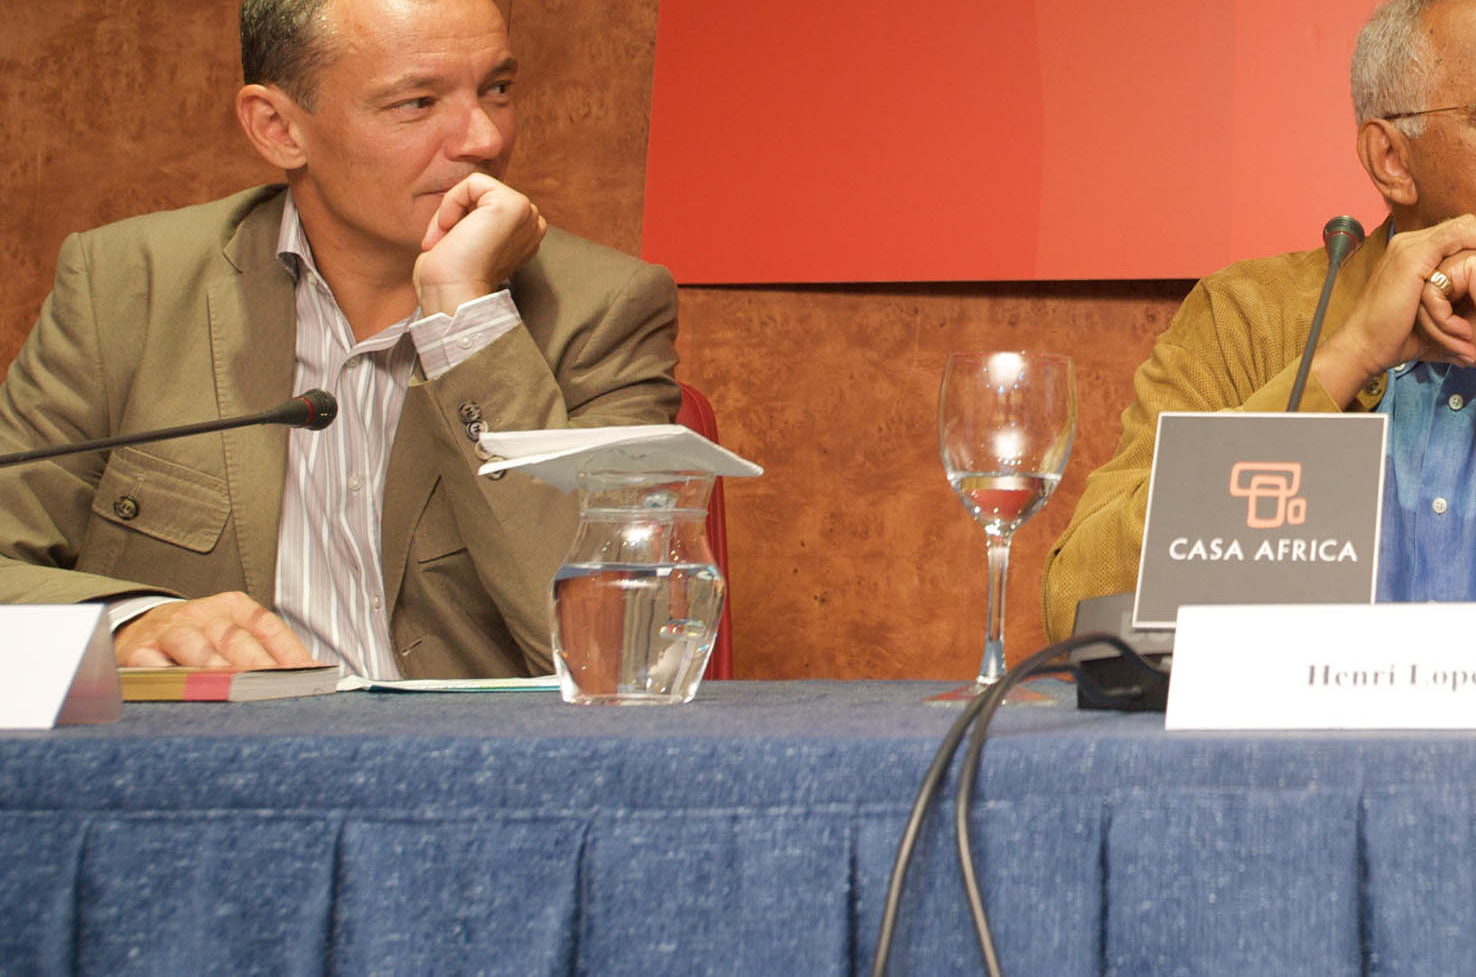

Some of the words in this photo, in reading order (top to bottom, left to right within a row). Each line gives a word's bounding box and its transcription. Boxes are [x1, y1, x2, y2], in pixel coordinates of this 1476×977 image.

[1168, 537, 1244, 561] CASA
[1253, 538, 1358, 563] AFRICA
[1308, 663, 1395, 687] Henri
